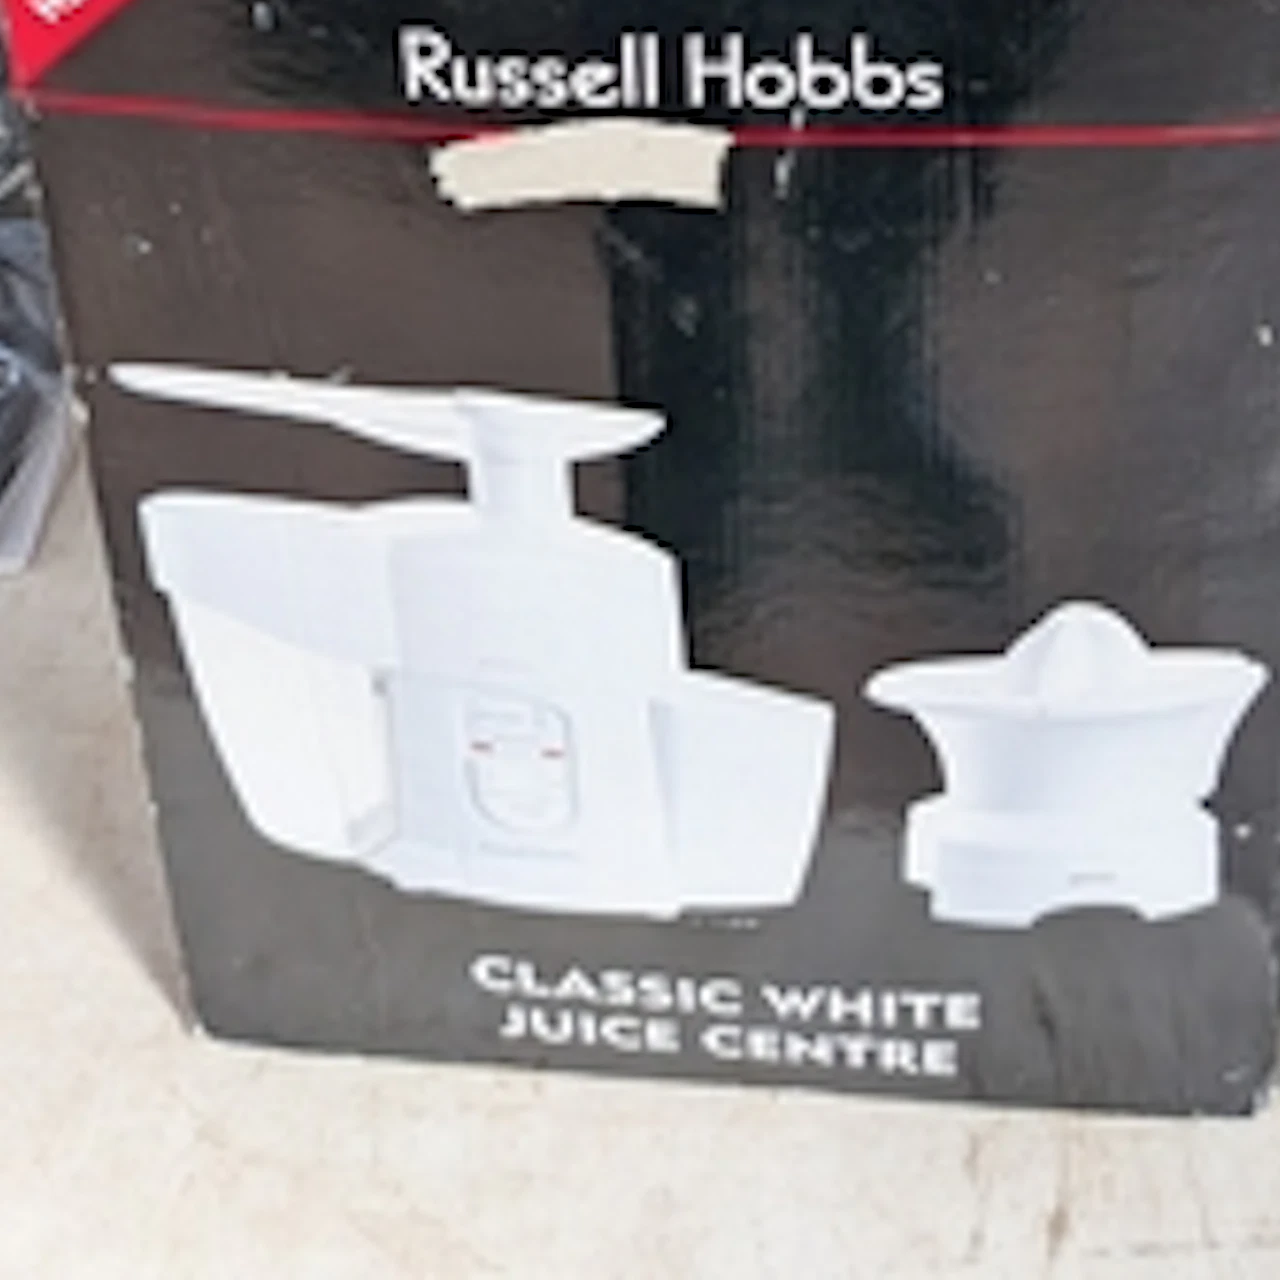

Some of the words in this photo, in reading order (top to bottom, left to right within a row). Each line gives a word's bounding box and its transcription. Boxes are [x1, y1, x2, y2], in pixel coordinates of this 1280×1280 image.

[401, 28, 658, 107] Russell
[688, 32, 944, 109] Hobbs
[469, 954, 743, 1015] CLASSIC
[760, 985, 982, 1030] WHITE
[498, 1006, 680, 1053] JUICE
[700, 1025, 958, 1076] CENTRE
